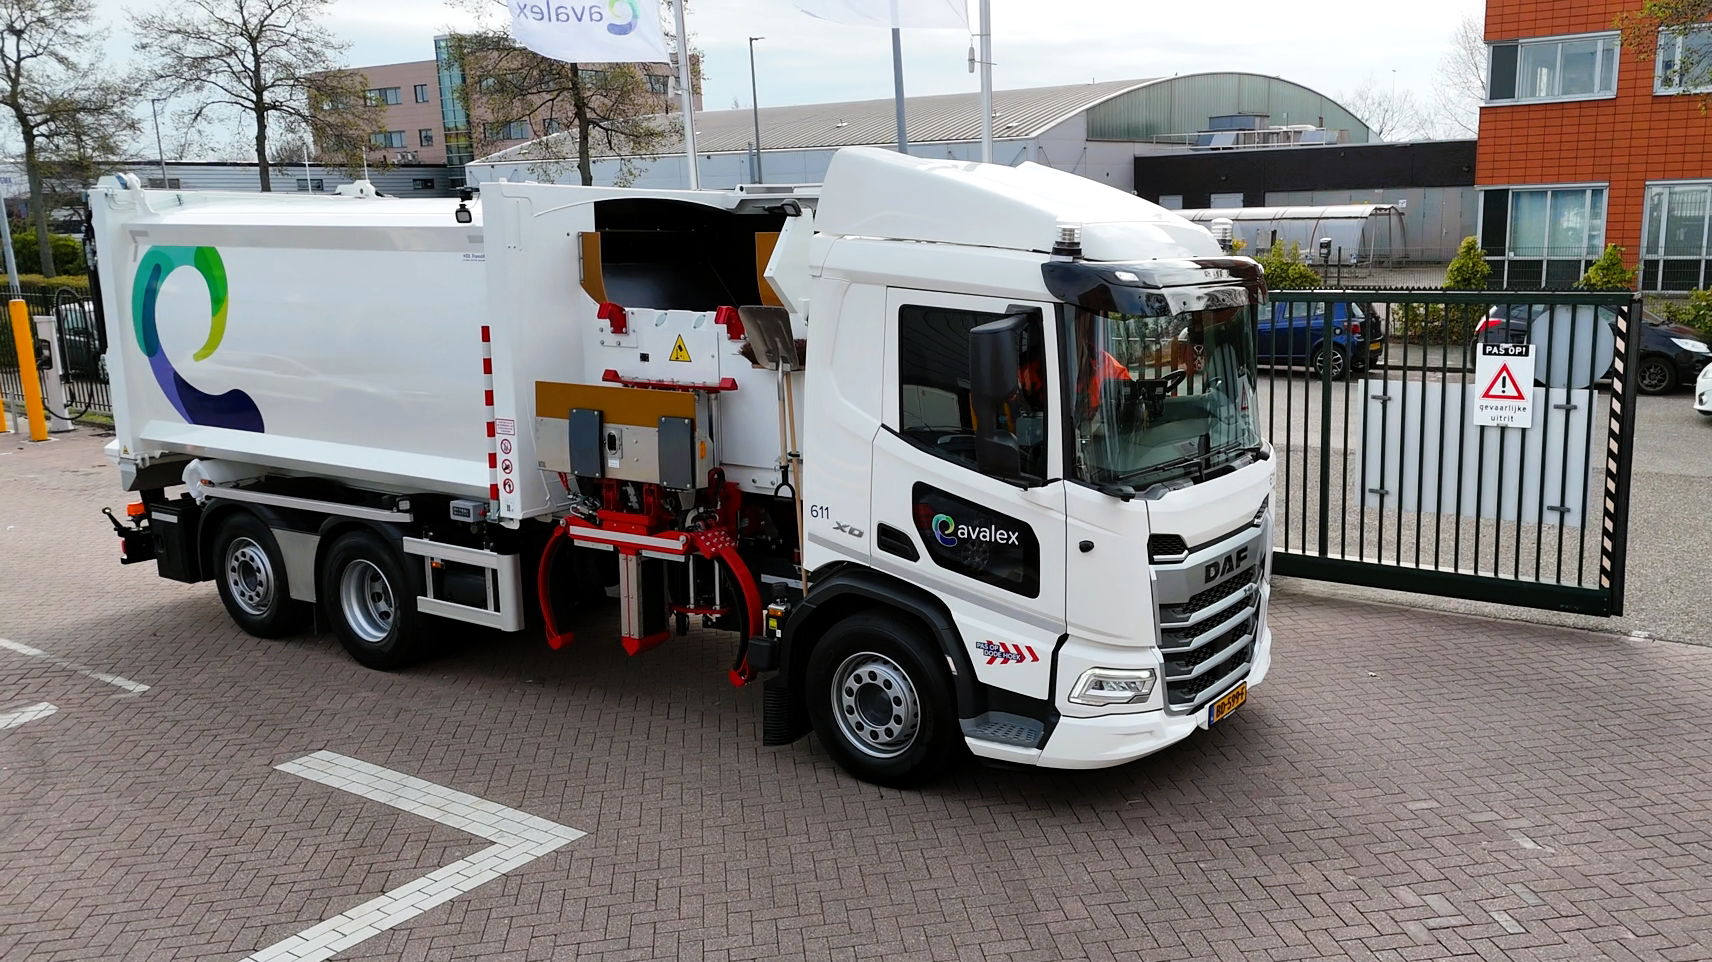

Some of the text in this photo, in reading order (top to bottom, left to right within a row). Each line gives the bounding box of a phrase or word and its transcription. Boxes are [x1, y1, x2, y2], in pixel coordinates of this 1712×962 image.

[1485, 346, 1526, 355] PAS OP!
[1479, 404, 1527, 413] gevaarlijke
[810, 504, 830, 520] 611
[832, 520, 864, 539] XD
[957, 524, 1019, 546] avalex
[1204, 545, 1248, 584] DAF
[976, 642, 989, 650] PAS
[985, 650, 1021, 660] DODE HOEK
